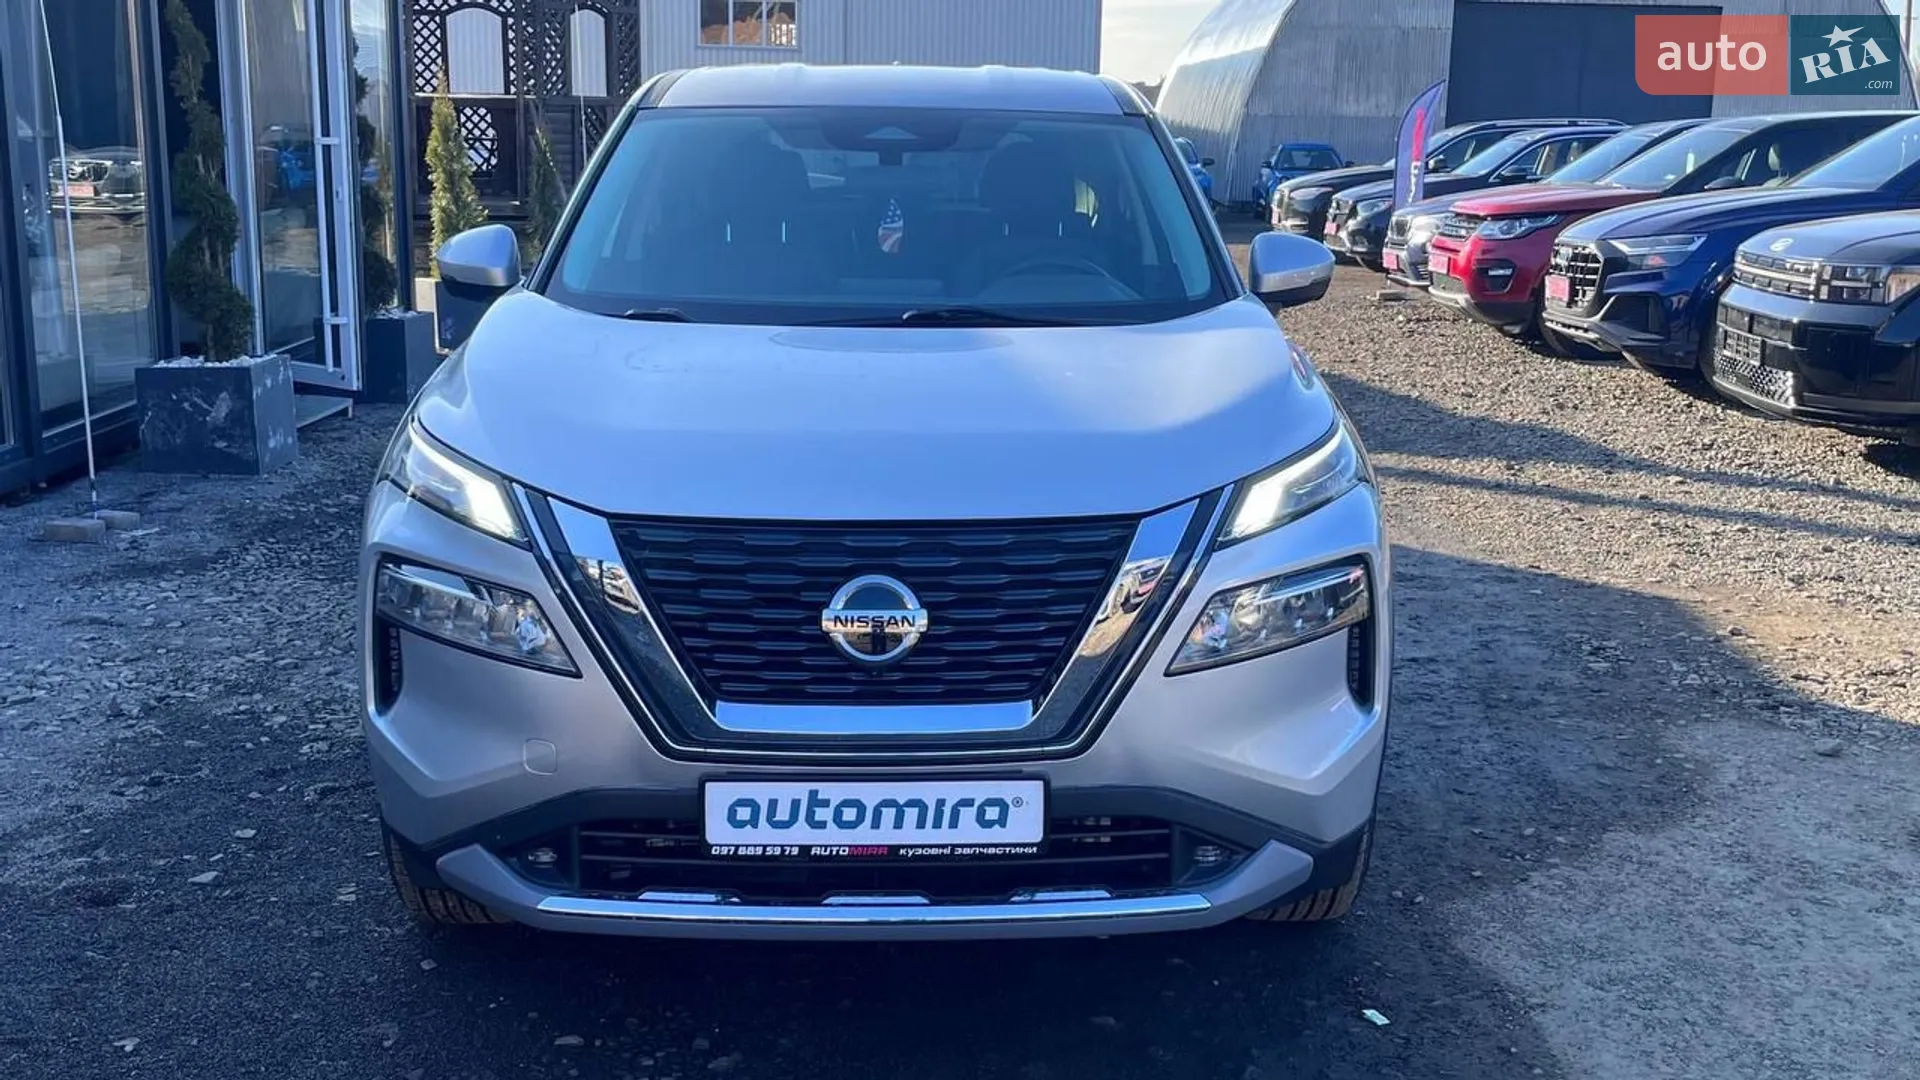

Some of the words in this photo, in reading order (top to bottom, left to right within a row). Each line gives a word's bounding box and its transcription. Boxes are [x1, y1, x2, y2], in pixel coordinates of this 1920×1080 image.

[833, 615, 916, 628] NISSAN
[726, 789, 1010, 830] automira
[711, 846, 735, 855] 097
[899, 845, 951, 857] кузовні
[954, 846, 1038, 855] запчастини
